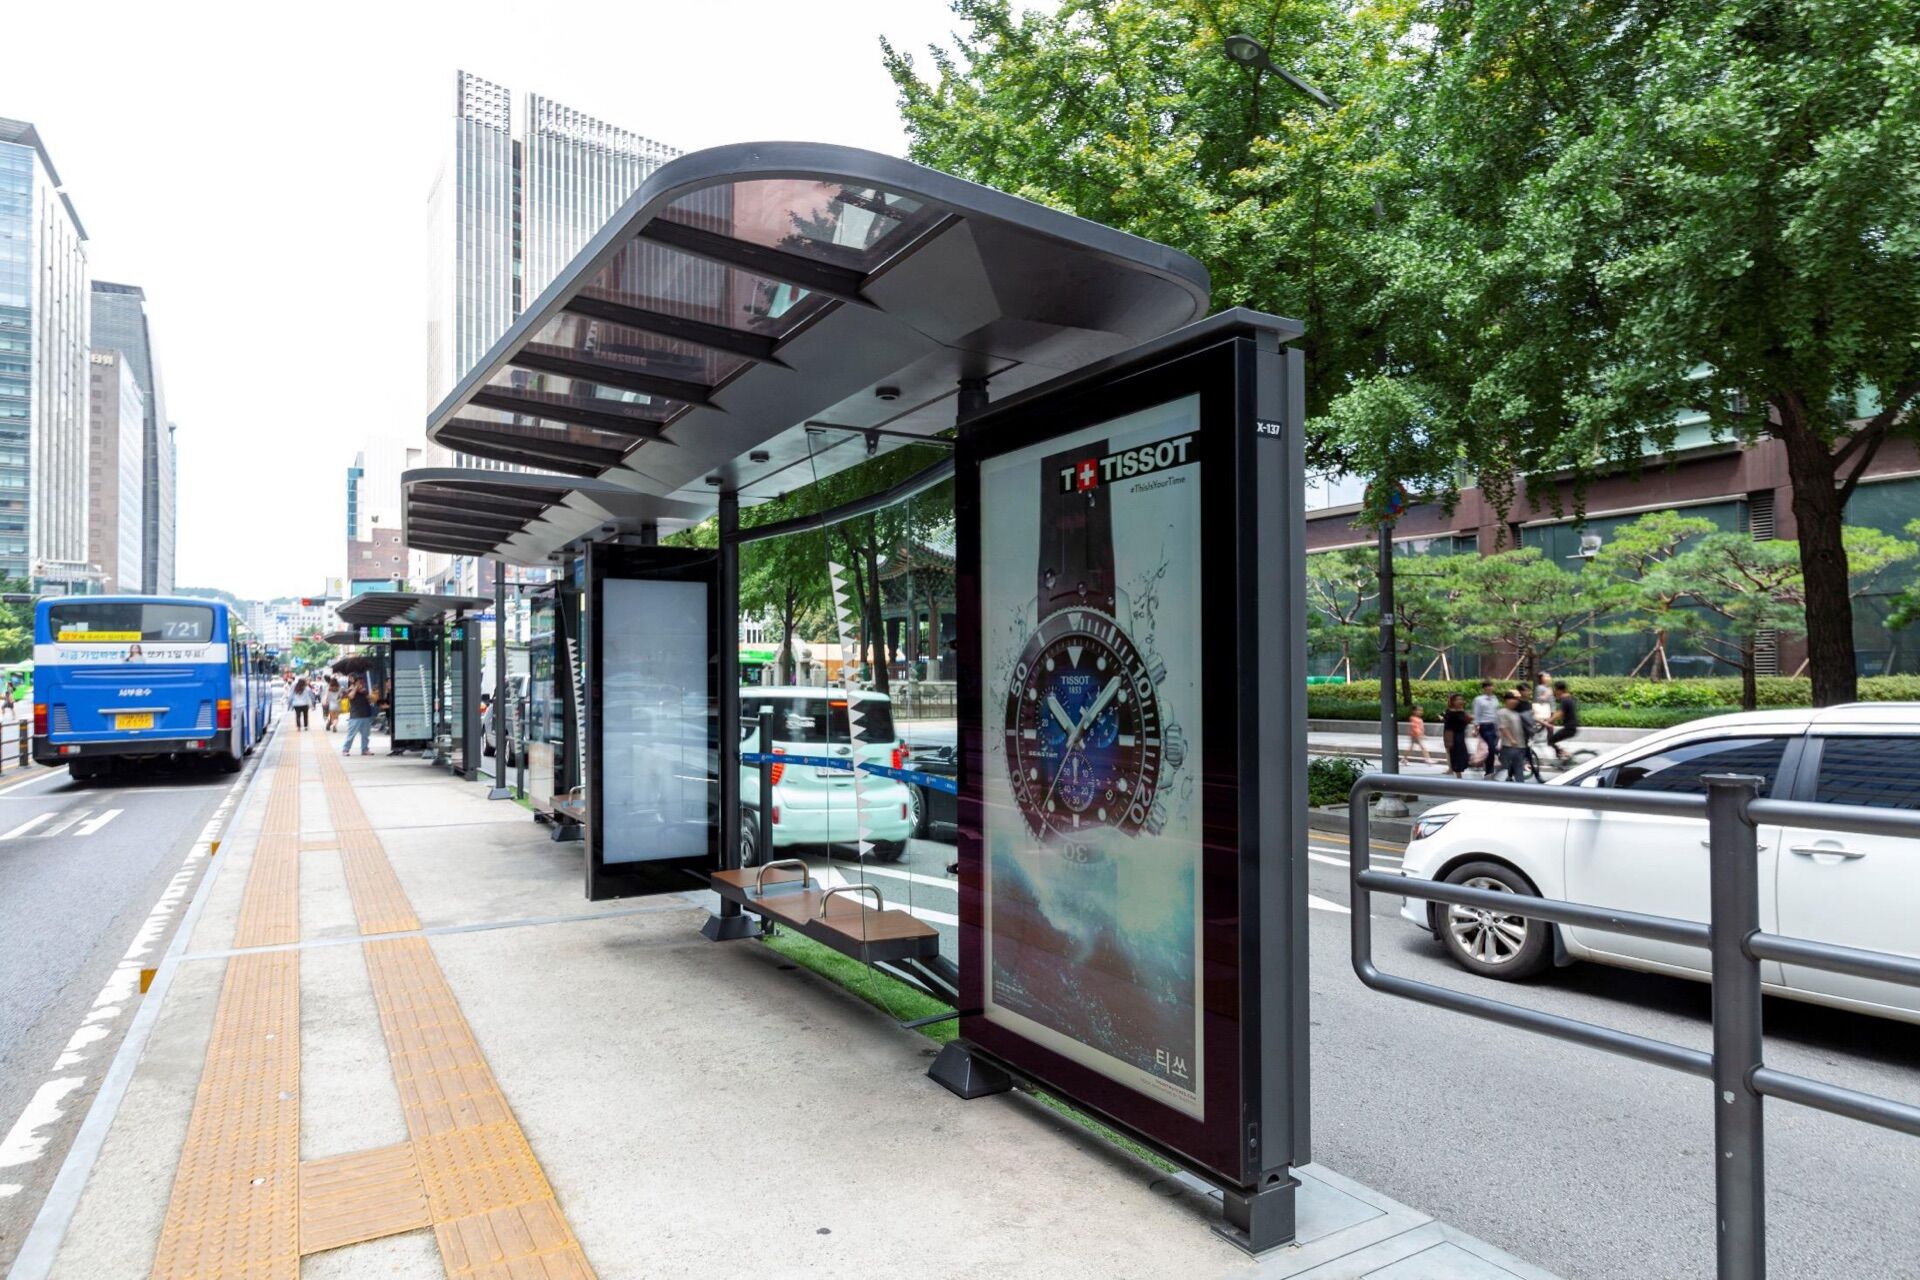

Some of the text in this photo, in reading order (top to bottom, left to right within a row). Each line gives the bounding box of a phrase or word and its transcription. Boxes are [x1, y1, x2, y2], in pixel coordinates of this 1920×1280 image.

[1256, 421, 1280, 435] X-137
[1100, 436, 1193, 481] TISSOT
[165, 621, 200, 637] 721
[1010, 662, 1027, 697] 50
[1060, 675, 1091, 685] TISSOT
[1133, 661, 1151, 699] 10
[1131, 782, 1152, 824] 20
[1156, 1048, 1189, 1079] 티쏘
